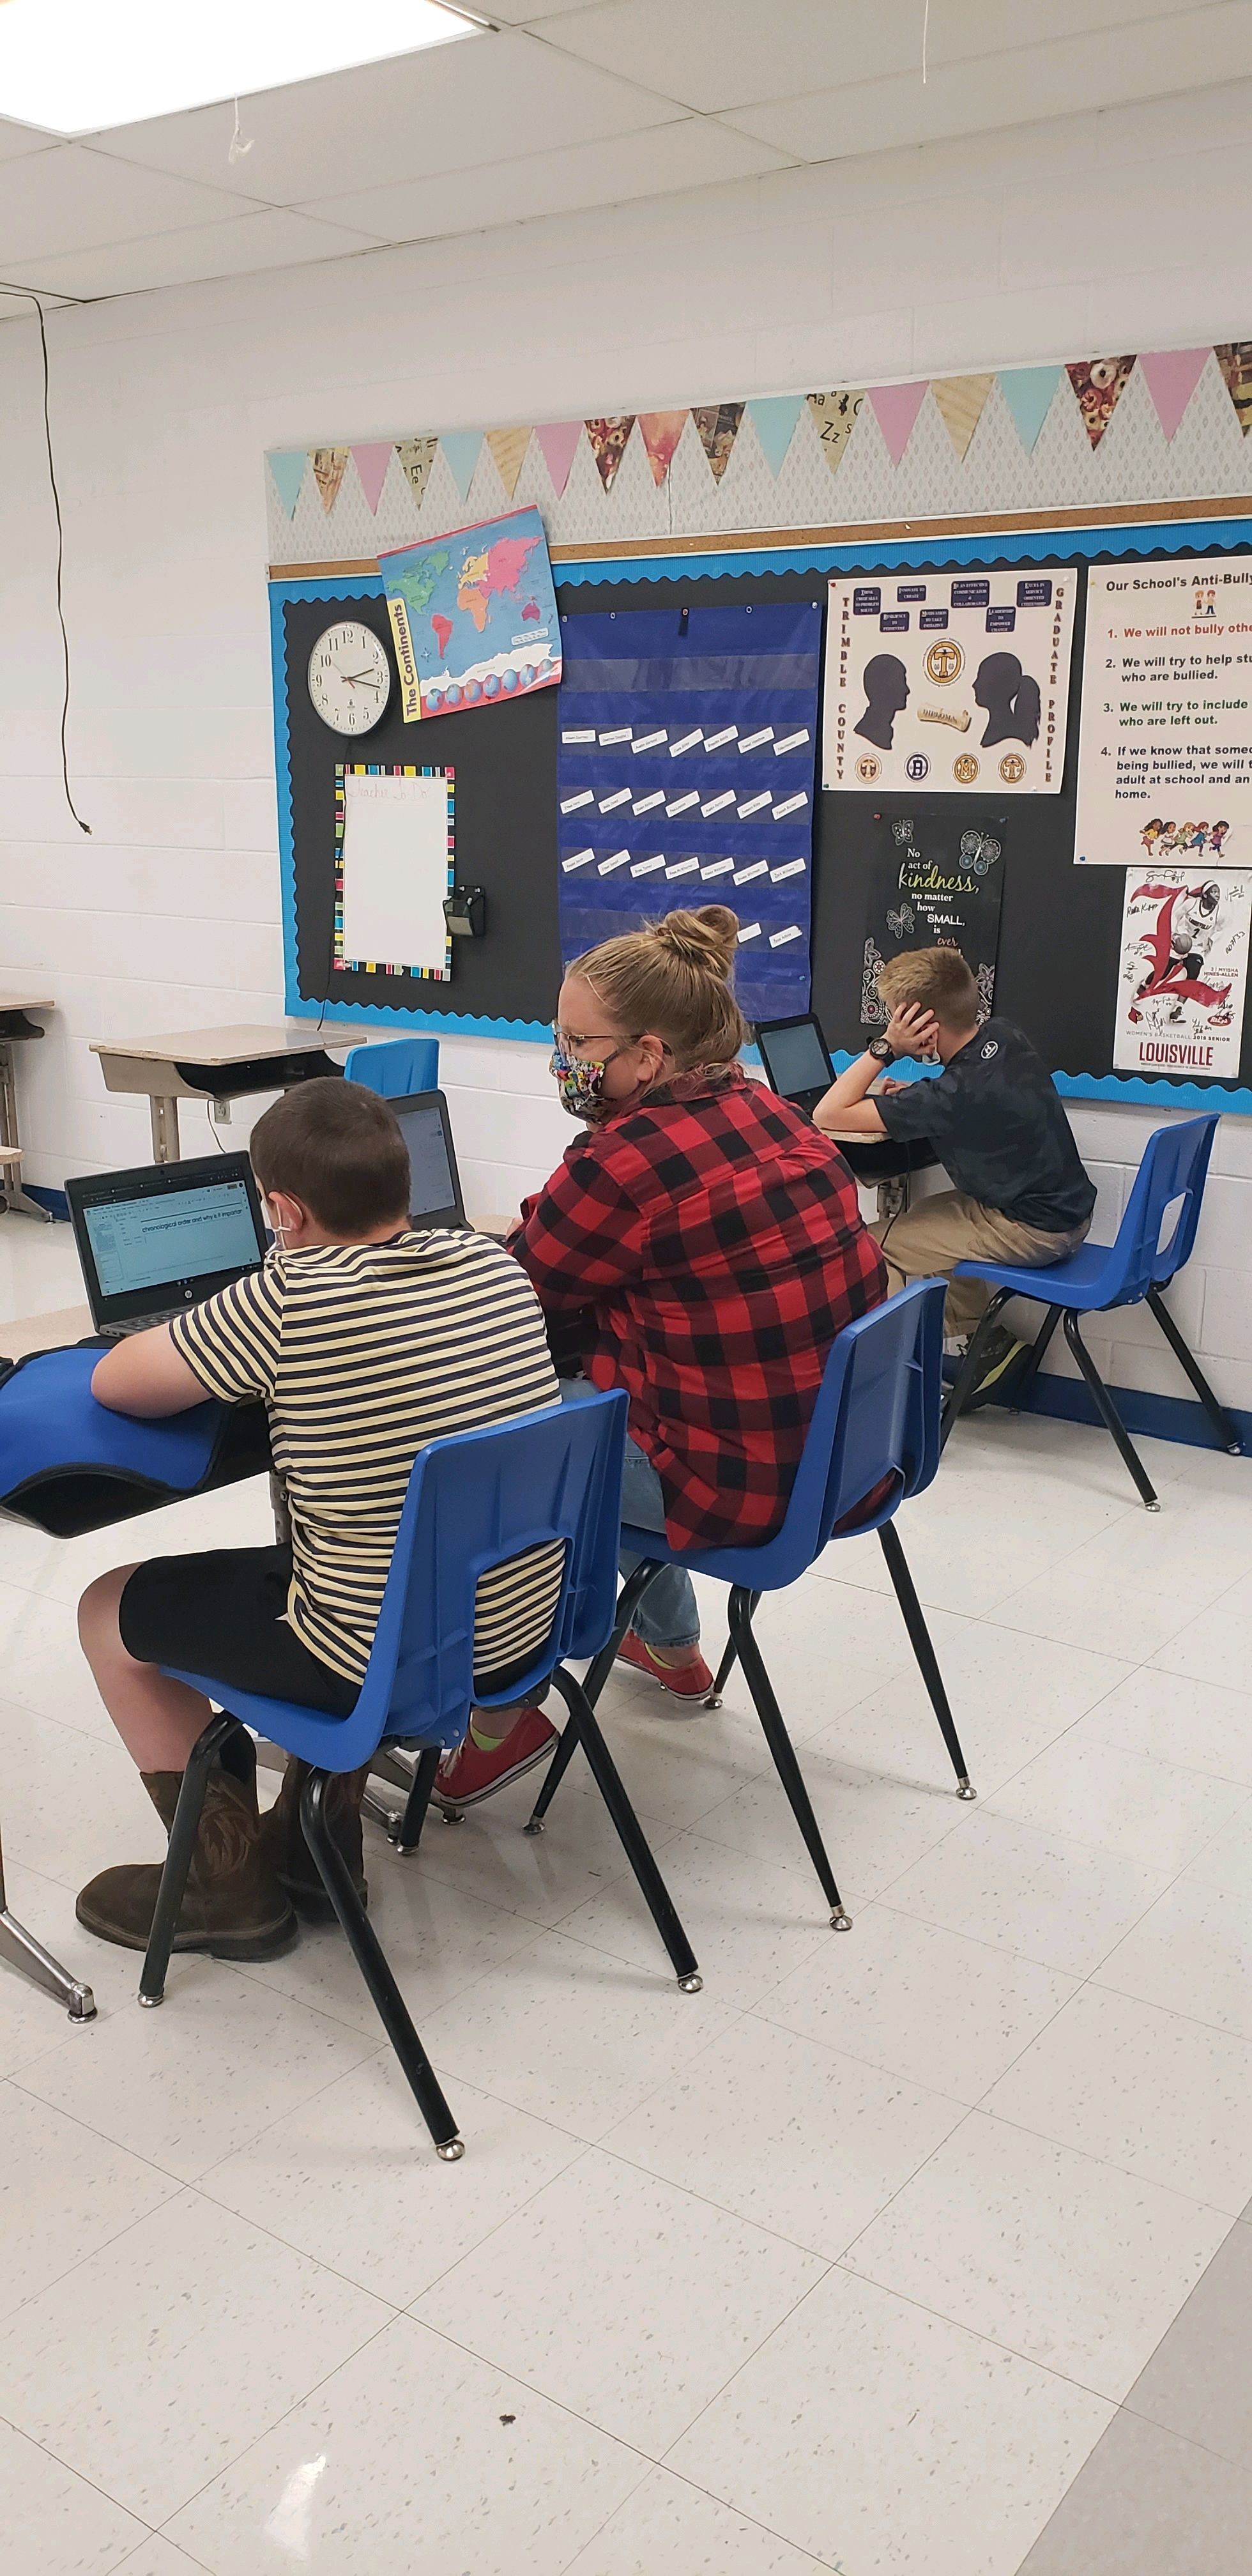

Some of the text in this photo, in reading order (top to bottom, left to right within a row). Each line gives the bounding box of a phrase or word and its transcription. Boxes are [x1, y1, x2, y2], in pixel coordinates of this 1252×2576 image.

[820, 421, 840, 443] Zz
[411, 464, 422, 484] Ee
[1106, 581, 1129, 591] Our
[1133, 577, 1187, 590] School's
[342, 630, 353, 644] 12
[1108, 629, 1118, 638] 1.
[1124, 628, 1142, 638] We
[1146, 627, 1167, 636] will
[1171, 625, 1191, 635] not
[1195, 624, 1225, 636] bully
[329, 638, 338, 651] 11
[362, 636, 365, 648] 1
[321, 654, 332, 668] 10
[373, 651, 379, 664] 2
[394, 604, 416, 716] The Continents
[1106, 659, 1116, 668] 2.
[1122, 658, 1140, 668] We
[1144, 657, 1165, 666] will
[1170, 657, 1186, 668] try
[1190, 656, 1202, 665] to
[1206, 654, 1232, 666] help
[316, 674, 322, 687] 9
[377, 671, 383, 684] 3
[1122, 670, 1218, 682] who are bullied.
[837, 597, 850, 779] TRIMBLE COUNTY
[1045, 588, 1064, 782] GRADUATE PROFILE
[322, 693, 328, 706] 8
[374, 690, 379, 703] 4
[1103, 700, 1248, 713] 3. We will try to include
[334, 708, 339, 721] 7
[349, 713, 355, 726] 6
[363, 707, 369, 720] 5
[923, 709, 958, 724] DIPLOMA
[1119, 717, 1143, 726] who
[1170, 716, 1190, 725] left
[1195, 716, 1218, 724] out.
[1101, 747, 1111, 756] 4.
[1117, 747, 1126, 756] If
[1150, 746, 1182, 755] know
[1186, 745, 1211, 755] that
[1117, 761, 1149, 772] being
[1153, 760, 1196, 771] bullied,
[1223, 760, 1244, 769] will
[1116, 775, 1145, 784] adult
[1149, 776, 1161, 784] at
[1164, 775, 1204, 783] school
[1209, 774, 1231, 783] and
[1115, 790, 1150, 799] home.
[907, 848, 920, 857] No
[922, 860, 933, 870] of
[898, 862, 979, 894] kindness,
[917, 901, 935, 912] how
[927, 914, 965, 926] SMALL,
[934, 924, 941, 933] is
[937, 937, 958, 946] ever
[1139, 1042, 1214, 1066] LOUISVILLE
[142, 1222, 177, 1233] chronological
